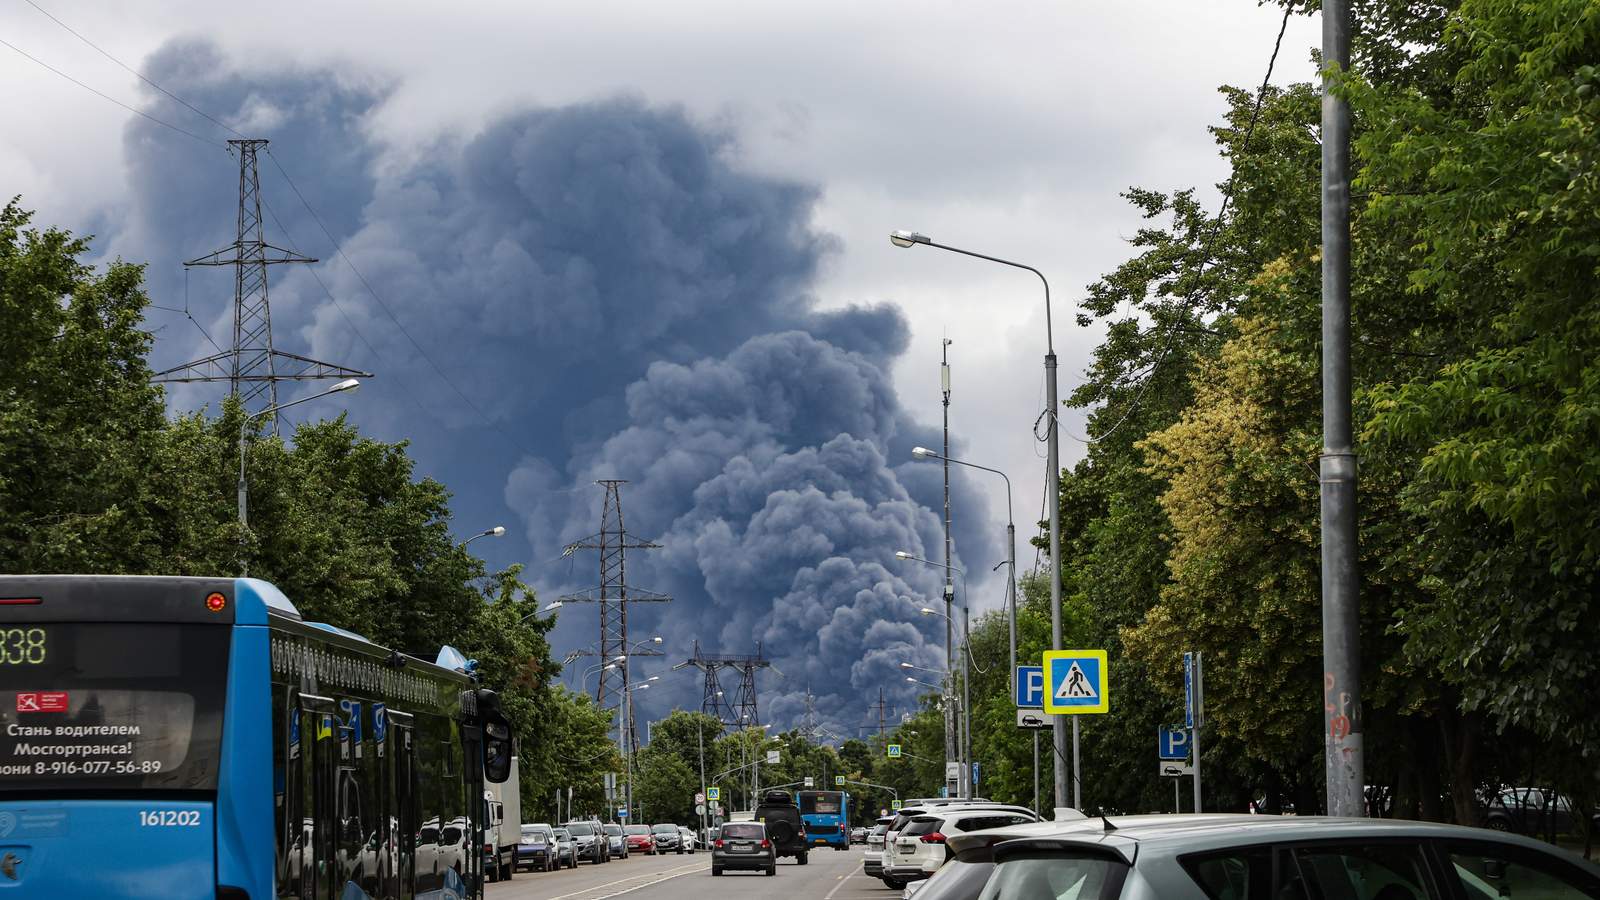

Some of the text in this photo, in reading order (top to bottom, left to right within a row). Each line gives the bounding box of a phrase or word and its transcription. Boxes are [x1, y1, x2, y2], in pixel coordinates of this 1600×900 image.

[1027, 671, 1043, 702] P
[7, 724, 140, 737] Стань водителем
[1169, 729, 1187, 754] P
[14, 742, 132, 757] Мосгортранса!
[0, 761, 161, 775] они 8-916-077-56-89
[140, 811, 200, 826] 161202
